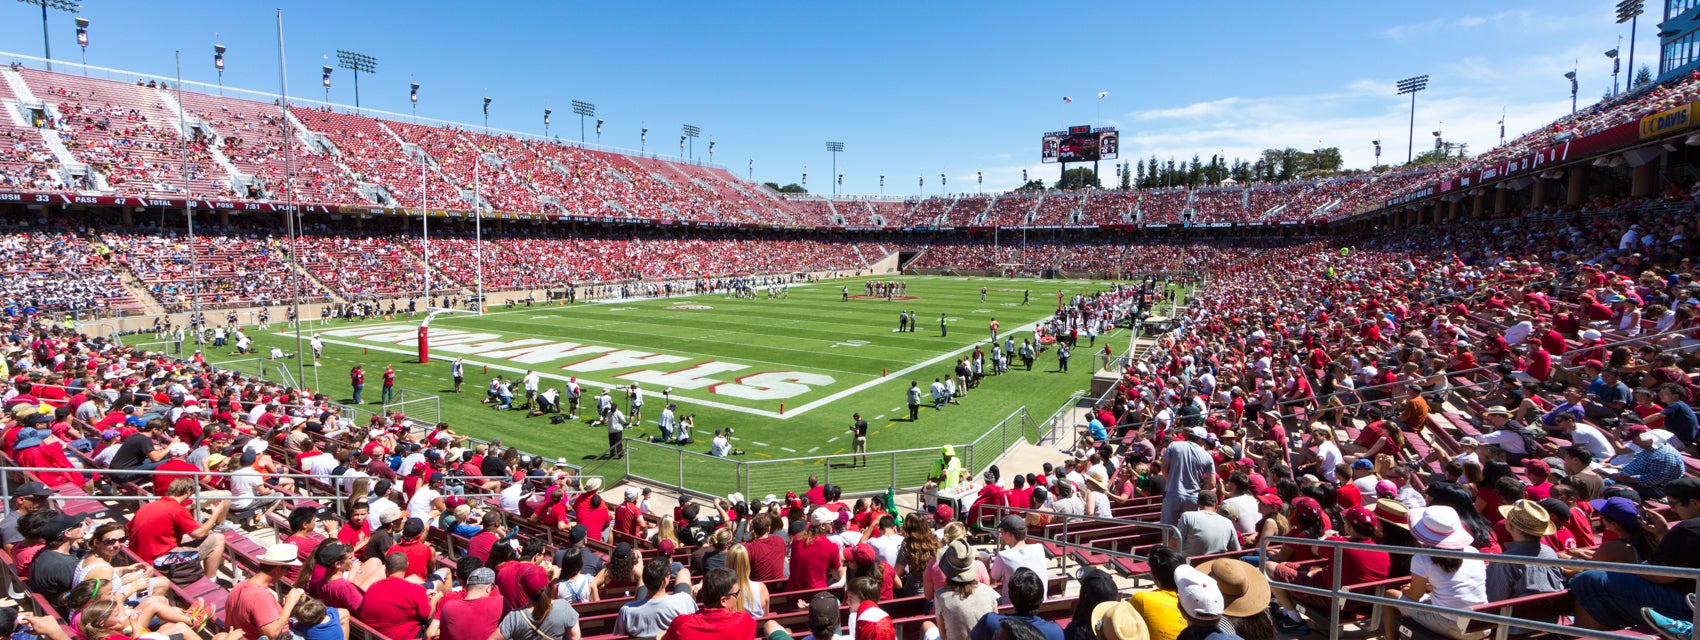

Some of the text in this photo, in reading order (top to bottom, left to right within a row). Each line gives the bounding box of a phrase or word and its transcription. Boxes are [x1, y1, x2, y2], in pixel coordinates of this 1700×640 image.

[35, 194, 49, 203] 33
[75, 196, 97, 204] PASS
[149, 199, 172, 207] TOTAL
[319, 325, 837, 400] STANFORD
